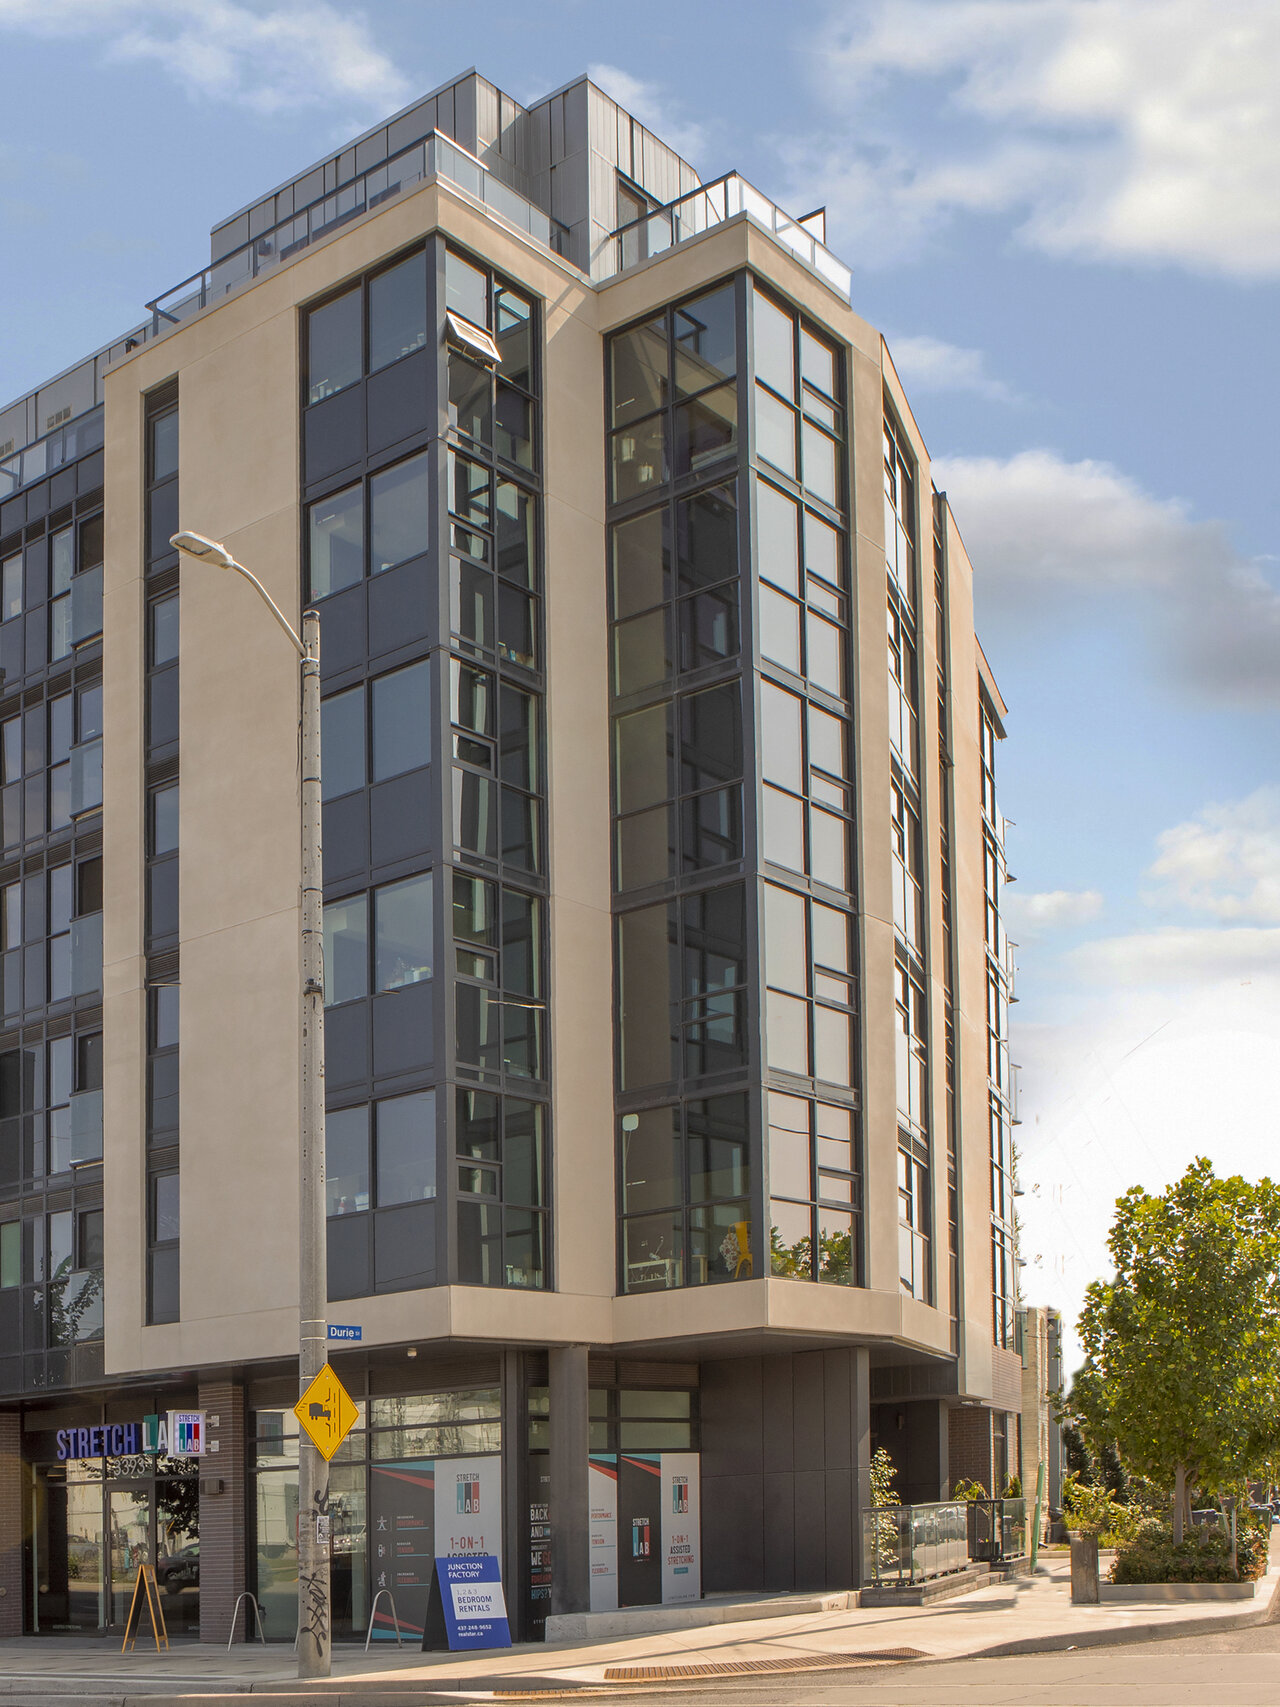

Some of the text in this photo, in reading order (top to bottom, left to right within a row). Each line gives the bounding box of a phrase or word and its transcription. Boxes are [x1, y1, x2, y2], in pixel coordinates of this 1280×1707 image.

[330, 1327, 354, 1337] Durie
[179, 1414, 200, 1422] STRETCH
[56, 1420, 169, 1460] STRETCH LA
[179, 1438, 200, 1452] LAB
[113, 1457, 145, 1476] 3393
[456, 1473, 480, 1482] STRETCH
[672, 1476, 688, 1484] STRETCH
[458, 1499, 479, 1513] LAB
[673, 1500, 688, 1513] LAB
[530, 1508, 548, 1521] BACK
[632, 1517, 650, 1526] STRETCH
[530, 1526, 544, 1538] AND
[450, 1536, 484, 1549] 1-ON-1
[672, 1535, 689, 1544] 1-ON-1
[633, 1541, 650, 1556] LAB
[670, 1545, 691, 1555] ASSISTED
[531, 1551, 542, 1566] WE
[667, 1555, 695, 1566] STRETCHING
[447, 1563, 483, 1571] JUNCTION
[448, 1571, 480, 1579] FACTORY
[457, 1595, 493, 1604] BEDROOM
[459, 1604, 491, 1613] RENTALS
